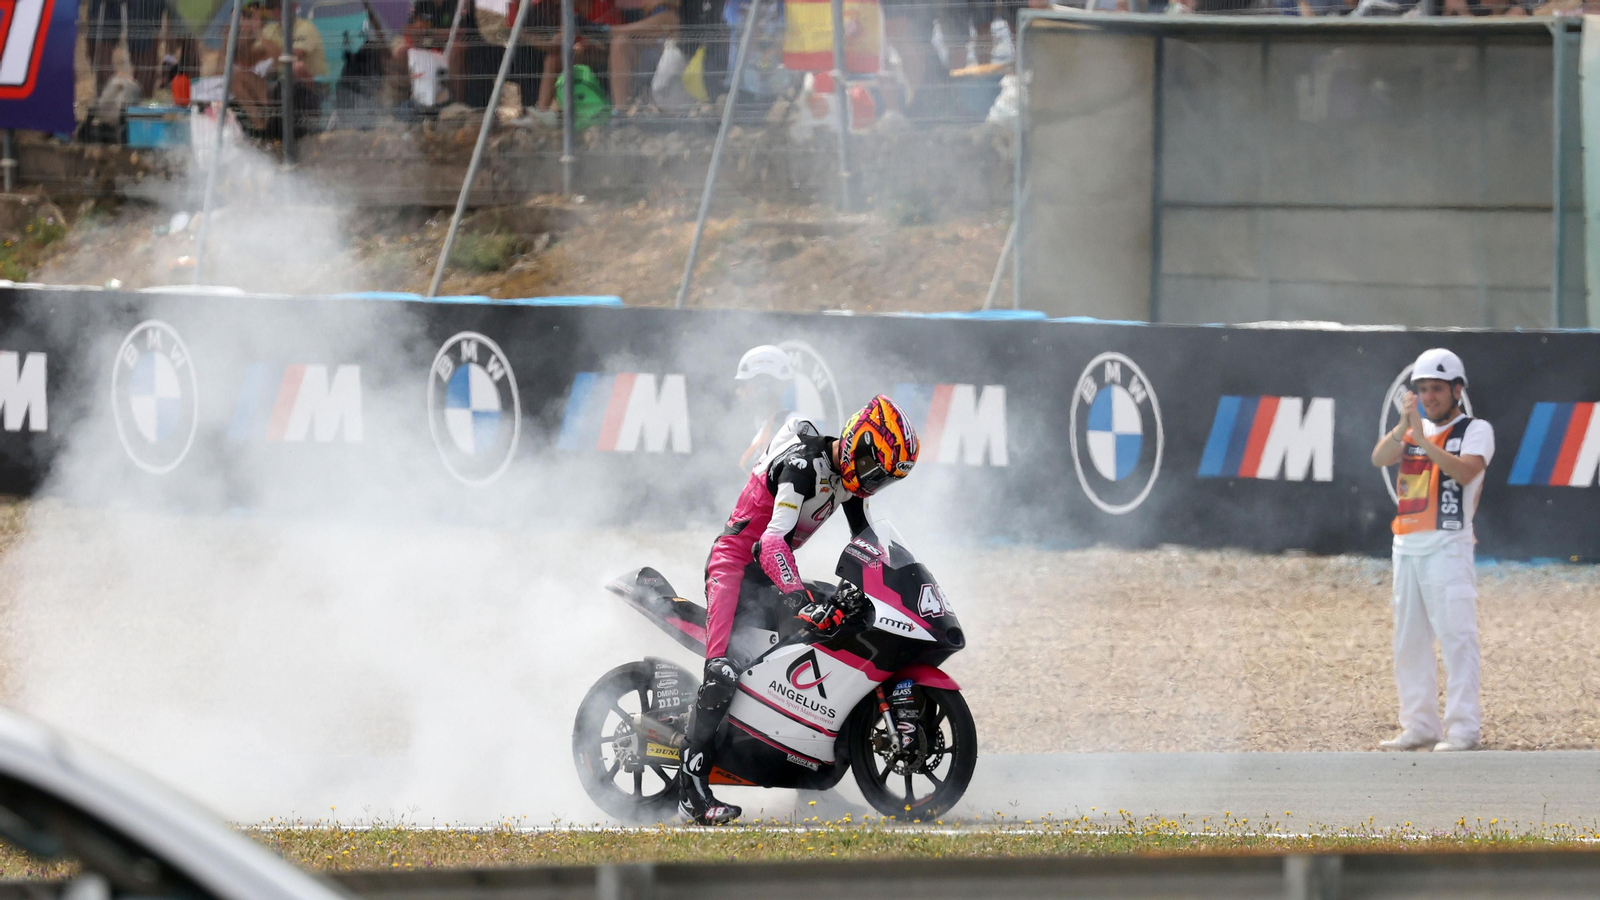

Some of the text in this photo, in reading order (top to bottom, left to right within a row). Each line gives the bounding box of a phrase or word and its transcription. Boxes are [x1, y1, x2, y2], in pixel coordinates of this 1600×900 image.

[124, 328, 187, 370] BMW
[437, 339, 505, 383] BMW
[284, 363, 363, 442] M
[1080, 361, 1148, 405] BMW
[614, 373, 692, 454] M
[936, 383, 1009, 467] M
[1256, 396, 1335, 482] M
[897, 461, 914, 472] NH
[767, 689, 834, 725] Women Sport Management
[768, 680, 837, 718] ANGELUSS
[893, 688, 911, 696] GLASS
